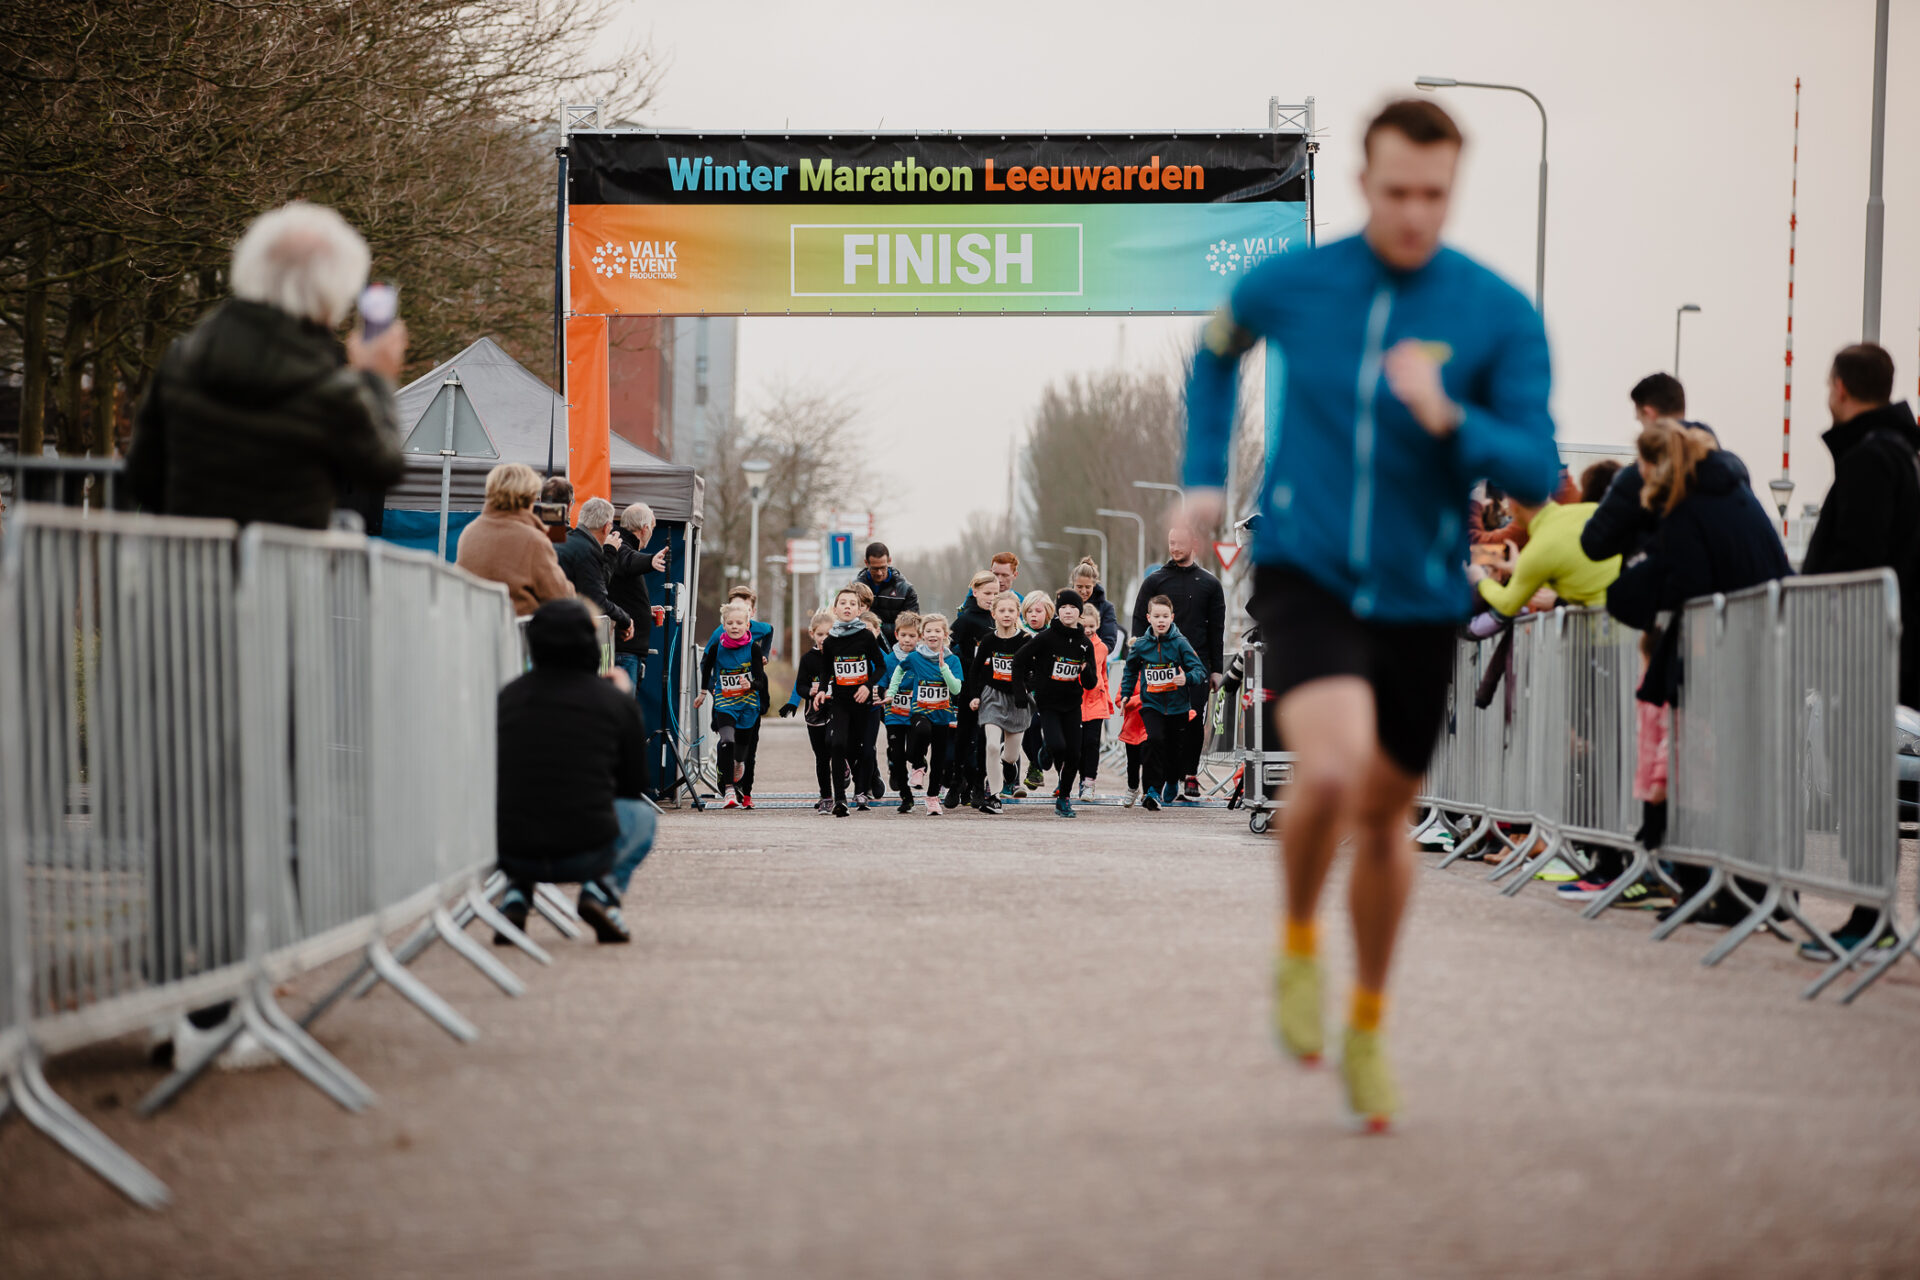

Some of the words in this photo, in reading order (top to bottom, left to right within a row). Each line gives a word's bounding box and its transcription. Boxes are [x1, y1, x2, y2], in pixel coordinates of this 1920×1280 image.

[667, 156, 789, 191] Winter
[799, 157, 973, 192] Marathon
[984, 155, 1205, 192] Leeuwarden
[629, 241, 677, 258] VALK
[1243, 237, 1290, 255] VALK
[629, 258, 677, 272] EVENT
[843, 233, 1033, 285] FINISH
[836, 662, 866, 674] 5013
[994, 659, 1012, 671] 503
[1056, 663, 1080, 676] 500
[1146, 669, 1174, 682] 5006
[919, 687, 948, 699] 5015
